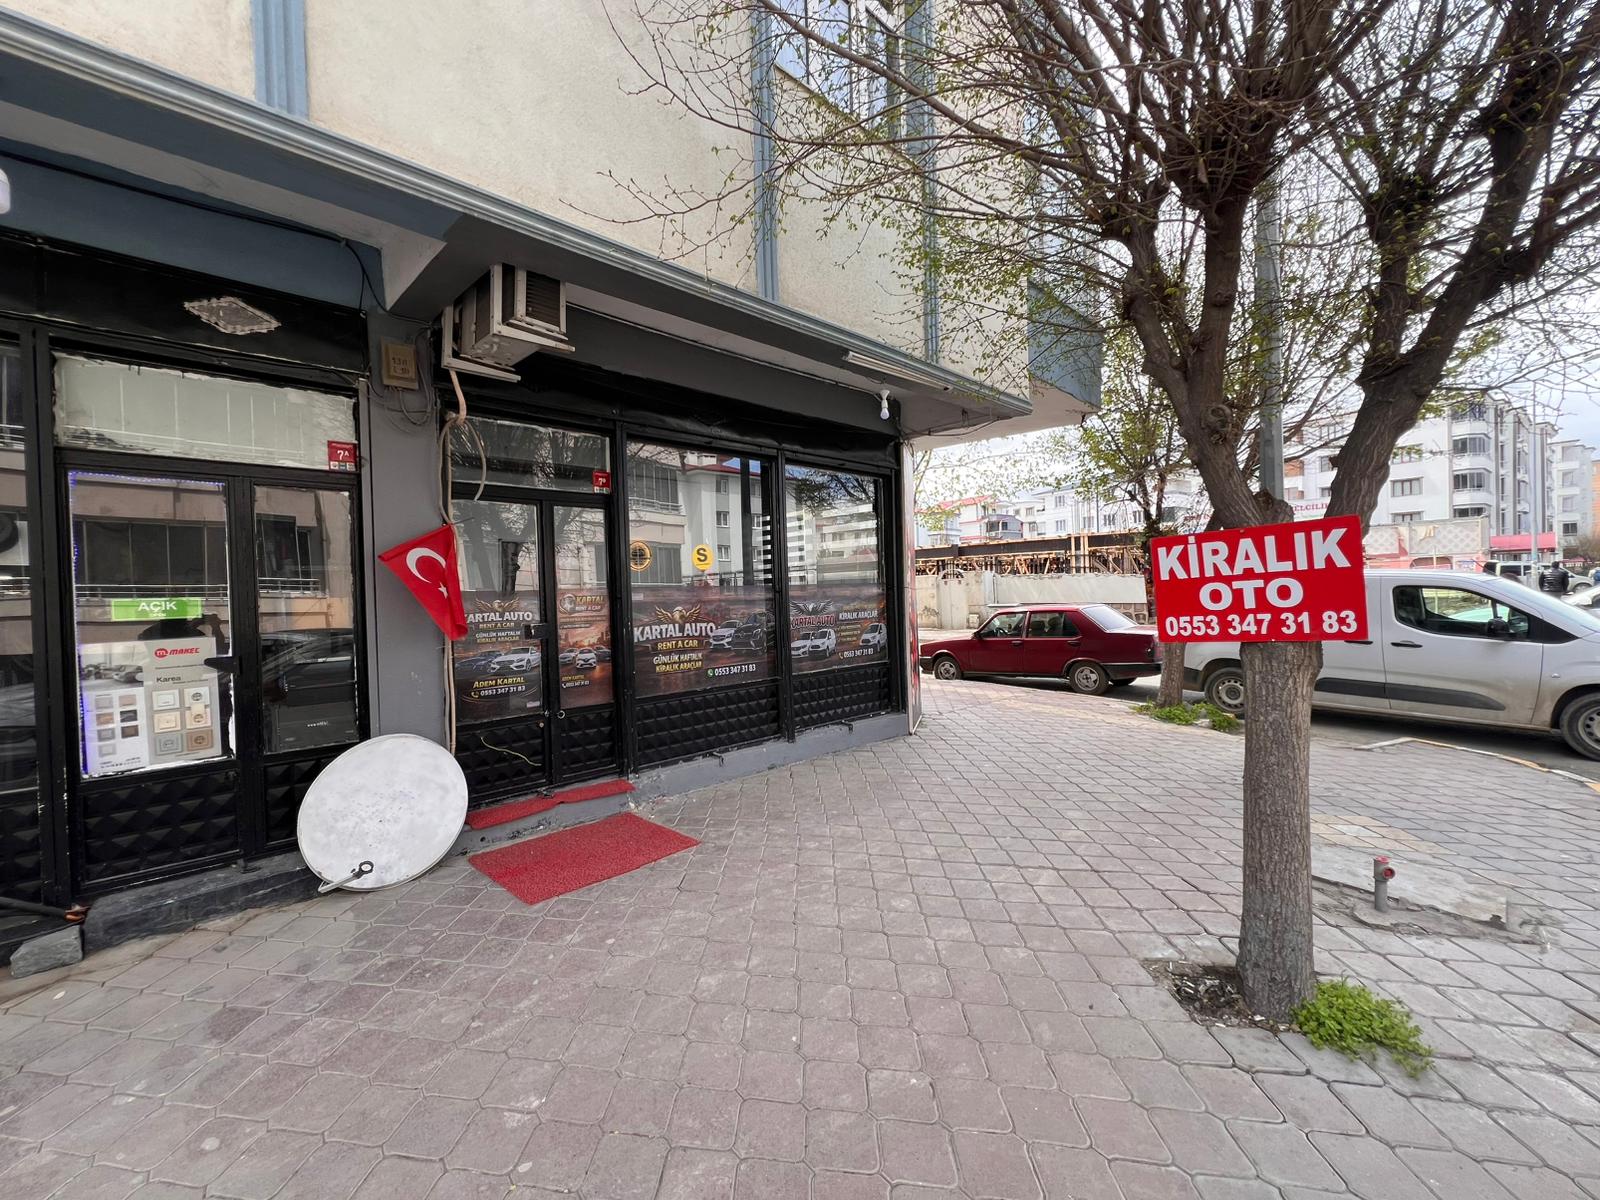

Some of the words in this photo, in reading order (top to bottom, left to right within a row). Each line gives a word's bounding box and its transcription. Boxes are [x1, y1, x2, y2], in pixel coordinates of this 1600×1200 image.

[697, 547, 708, 562] S
[1157, 527, 1351, 580] KİRALIK
[1199, 577, 1304, 611] OTO
[137, 601, 177, 612] AÇIK
[465, 612, 502, 623] ARTAL
[503, 611, 533, 621] AUTO
[1165, 615, 1220, 636] 0553
[1227, 613, 1271, 635] 347
[1281, 611, 1311, 634] 31
[1322, 610, 1358, 633] 83
[633, 623, 683, 642] KARTAL
[683, 622, 716, 637] AUTO
[657, 641, 675, 650] RENT
[676, 640, 683, 649] A
[683, 639, 698, 647] CAR
[653, 653, 679, 665] GÜNLÜK
[714, 667, 730, 676] 0553
[730, 665, 741, 674] 347
[741, 664, 749, 673] 31
[748, 664, 756, 672] 83
[473, 680, 496, 689] ADEM
[497, 677, 525, 686] KARTAL
